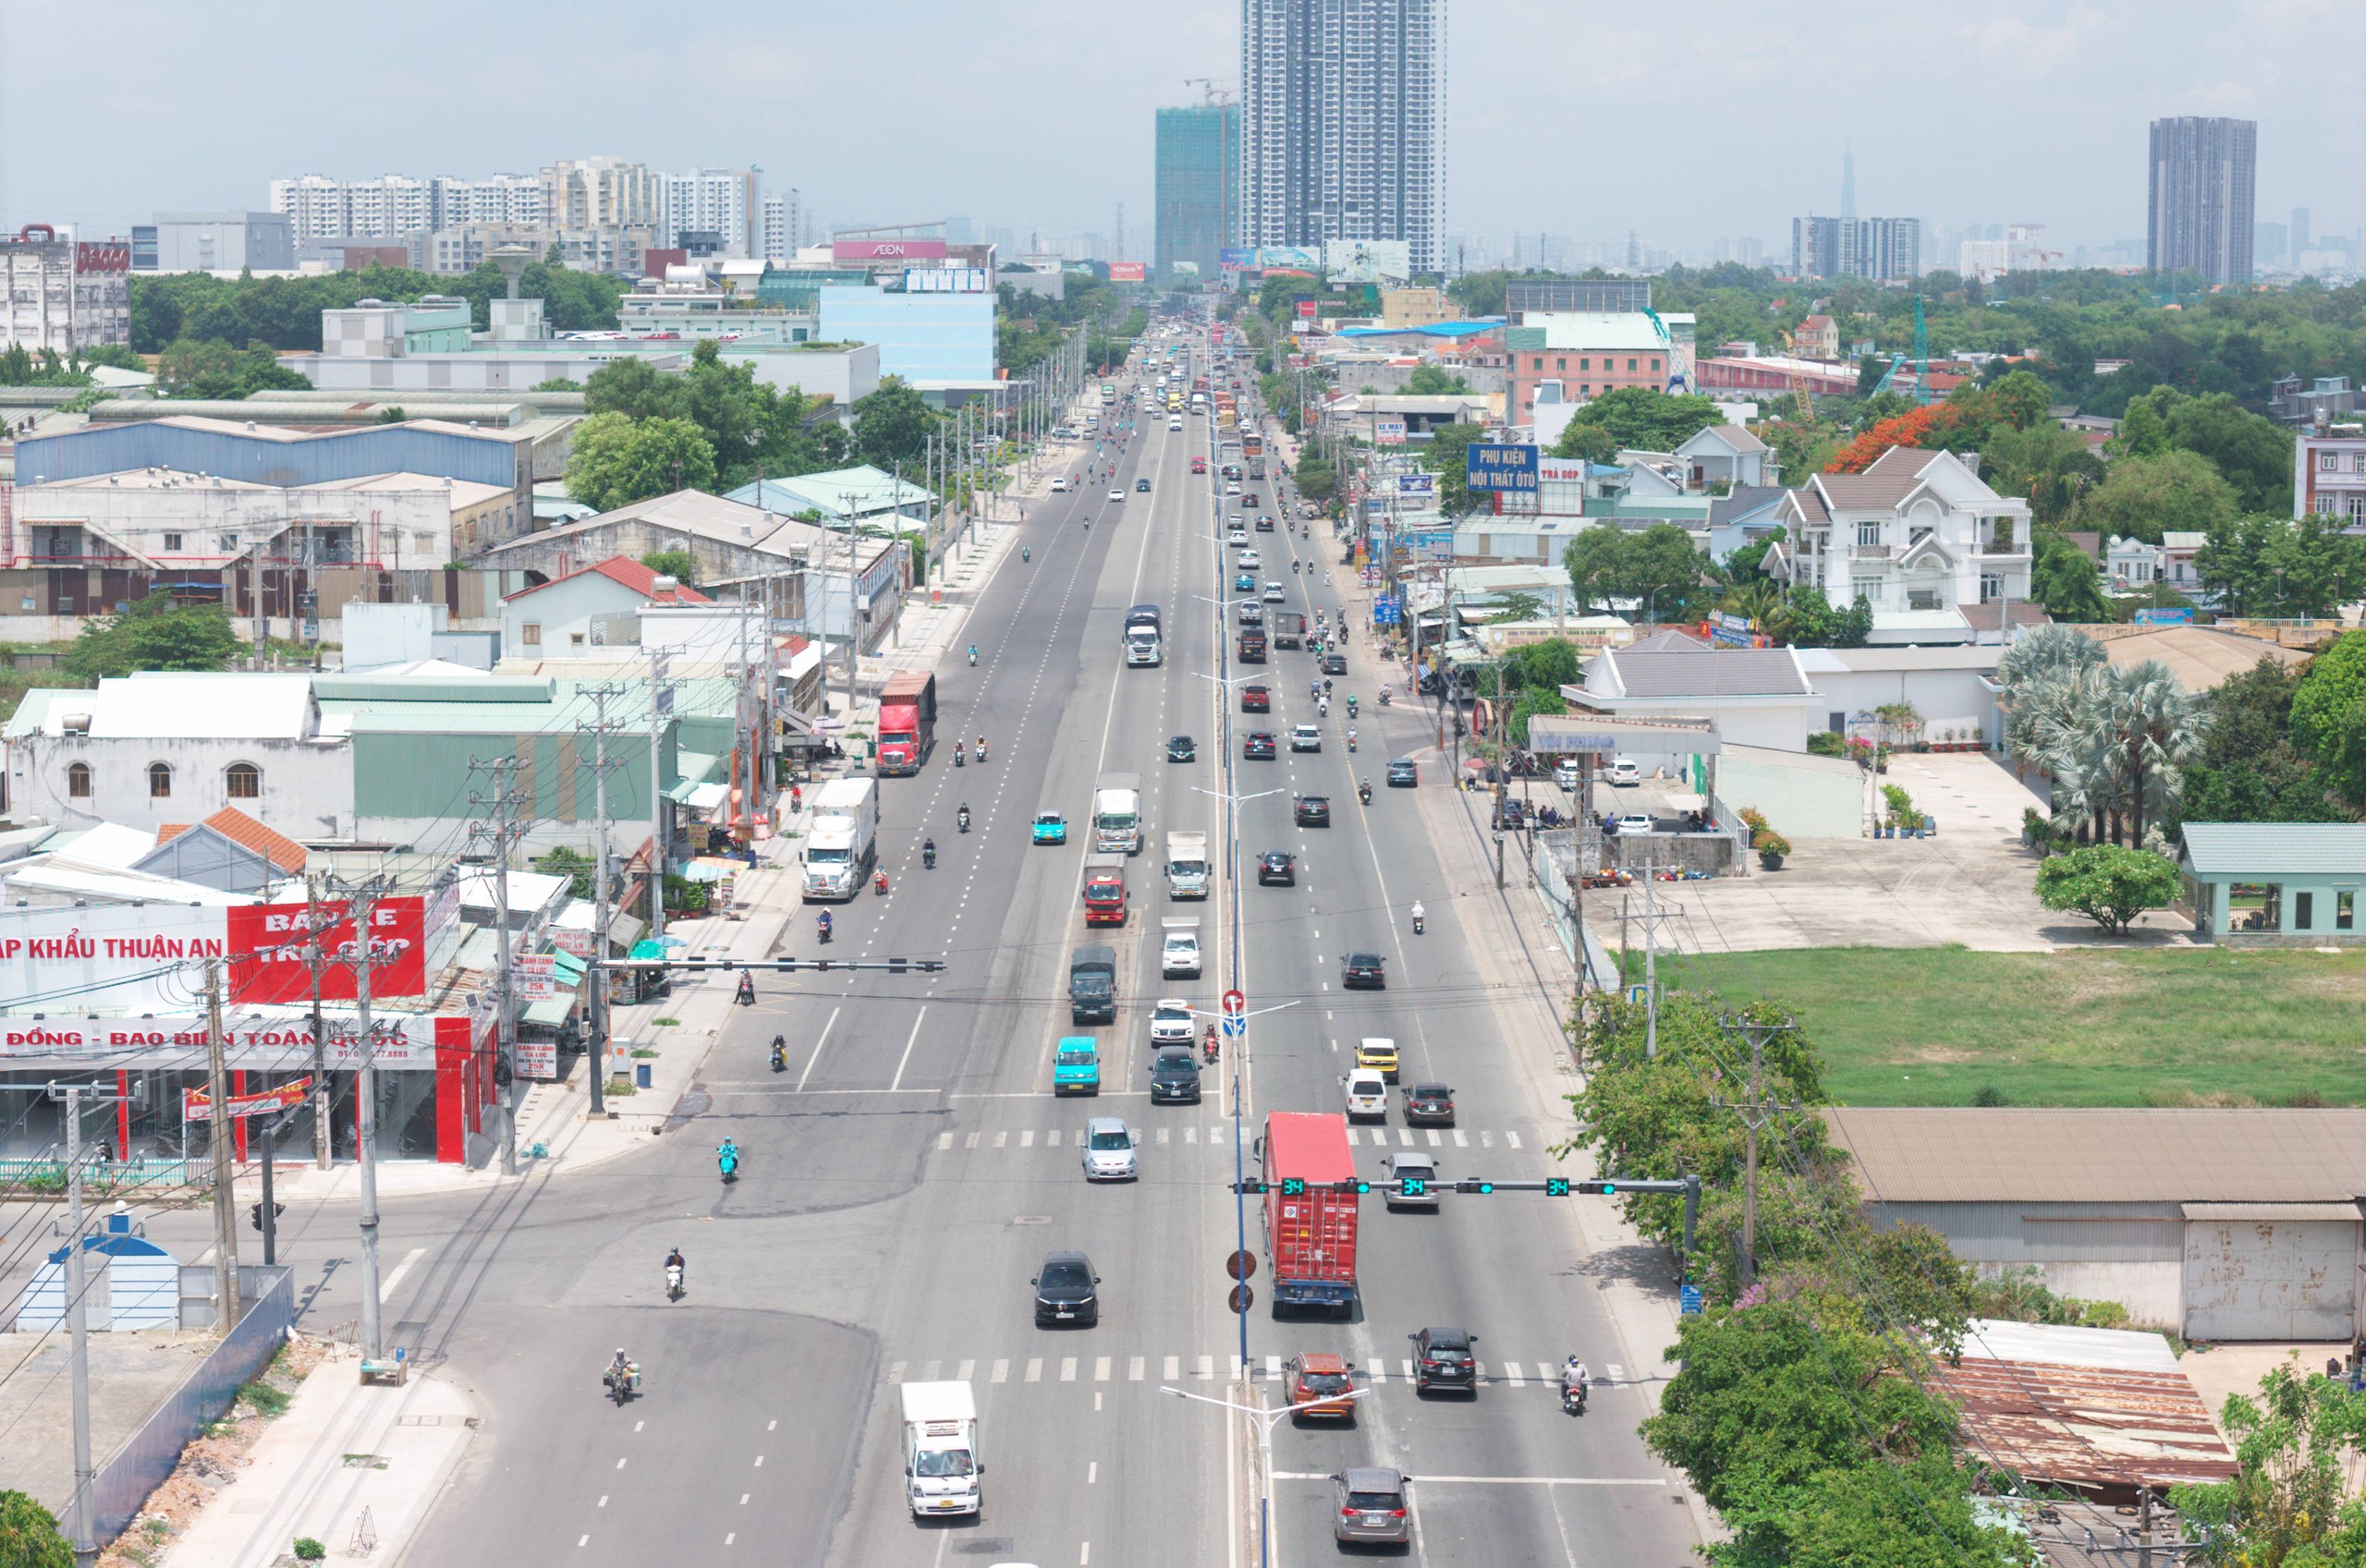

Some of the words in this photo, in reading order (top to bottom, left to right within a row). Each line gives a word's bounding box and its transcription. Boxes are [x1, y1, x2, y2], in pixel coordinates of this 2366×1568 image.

[76, 242, 129, 274] Dacco
[1480, 449, 1500, 468] PHỤ
[1503, 447, 1526, 468] KIỆN
[1470, 469, 1488, 489] NỘI
[1490, 468, 1514, 487] THẤT
[1517, 470, 1535, 488] ÔTÔ
[1542, 467, 1558, 479] TRẢ
[1562, 468, 1579, 480] GÓP
[0, 939, 21, 958] P
[29, 928, 94, 959] KHẨU
[103, 934, 183, 963] THUẬN
[189, 939, 222, 958] AN
[529, 982, 544, 991] 25K
[6, 1027, 82, 1046] ĐỒNG
[110, 1032, 165, 1046] BAO
[244, 1028, 316, 1046] TOÀN
[1283, 1179, 1304, 1195] 34
[1403, 1178, 1424, 1195] 34
[1548, 1179, 1568, 1196] 34
